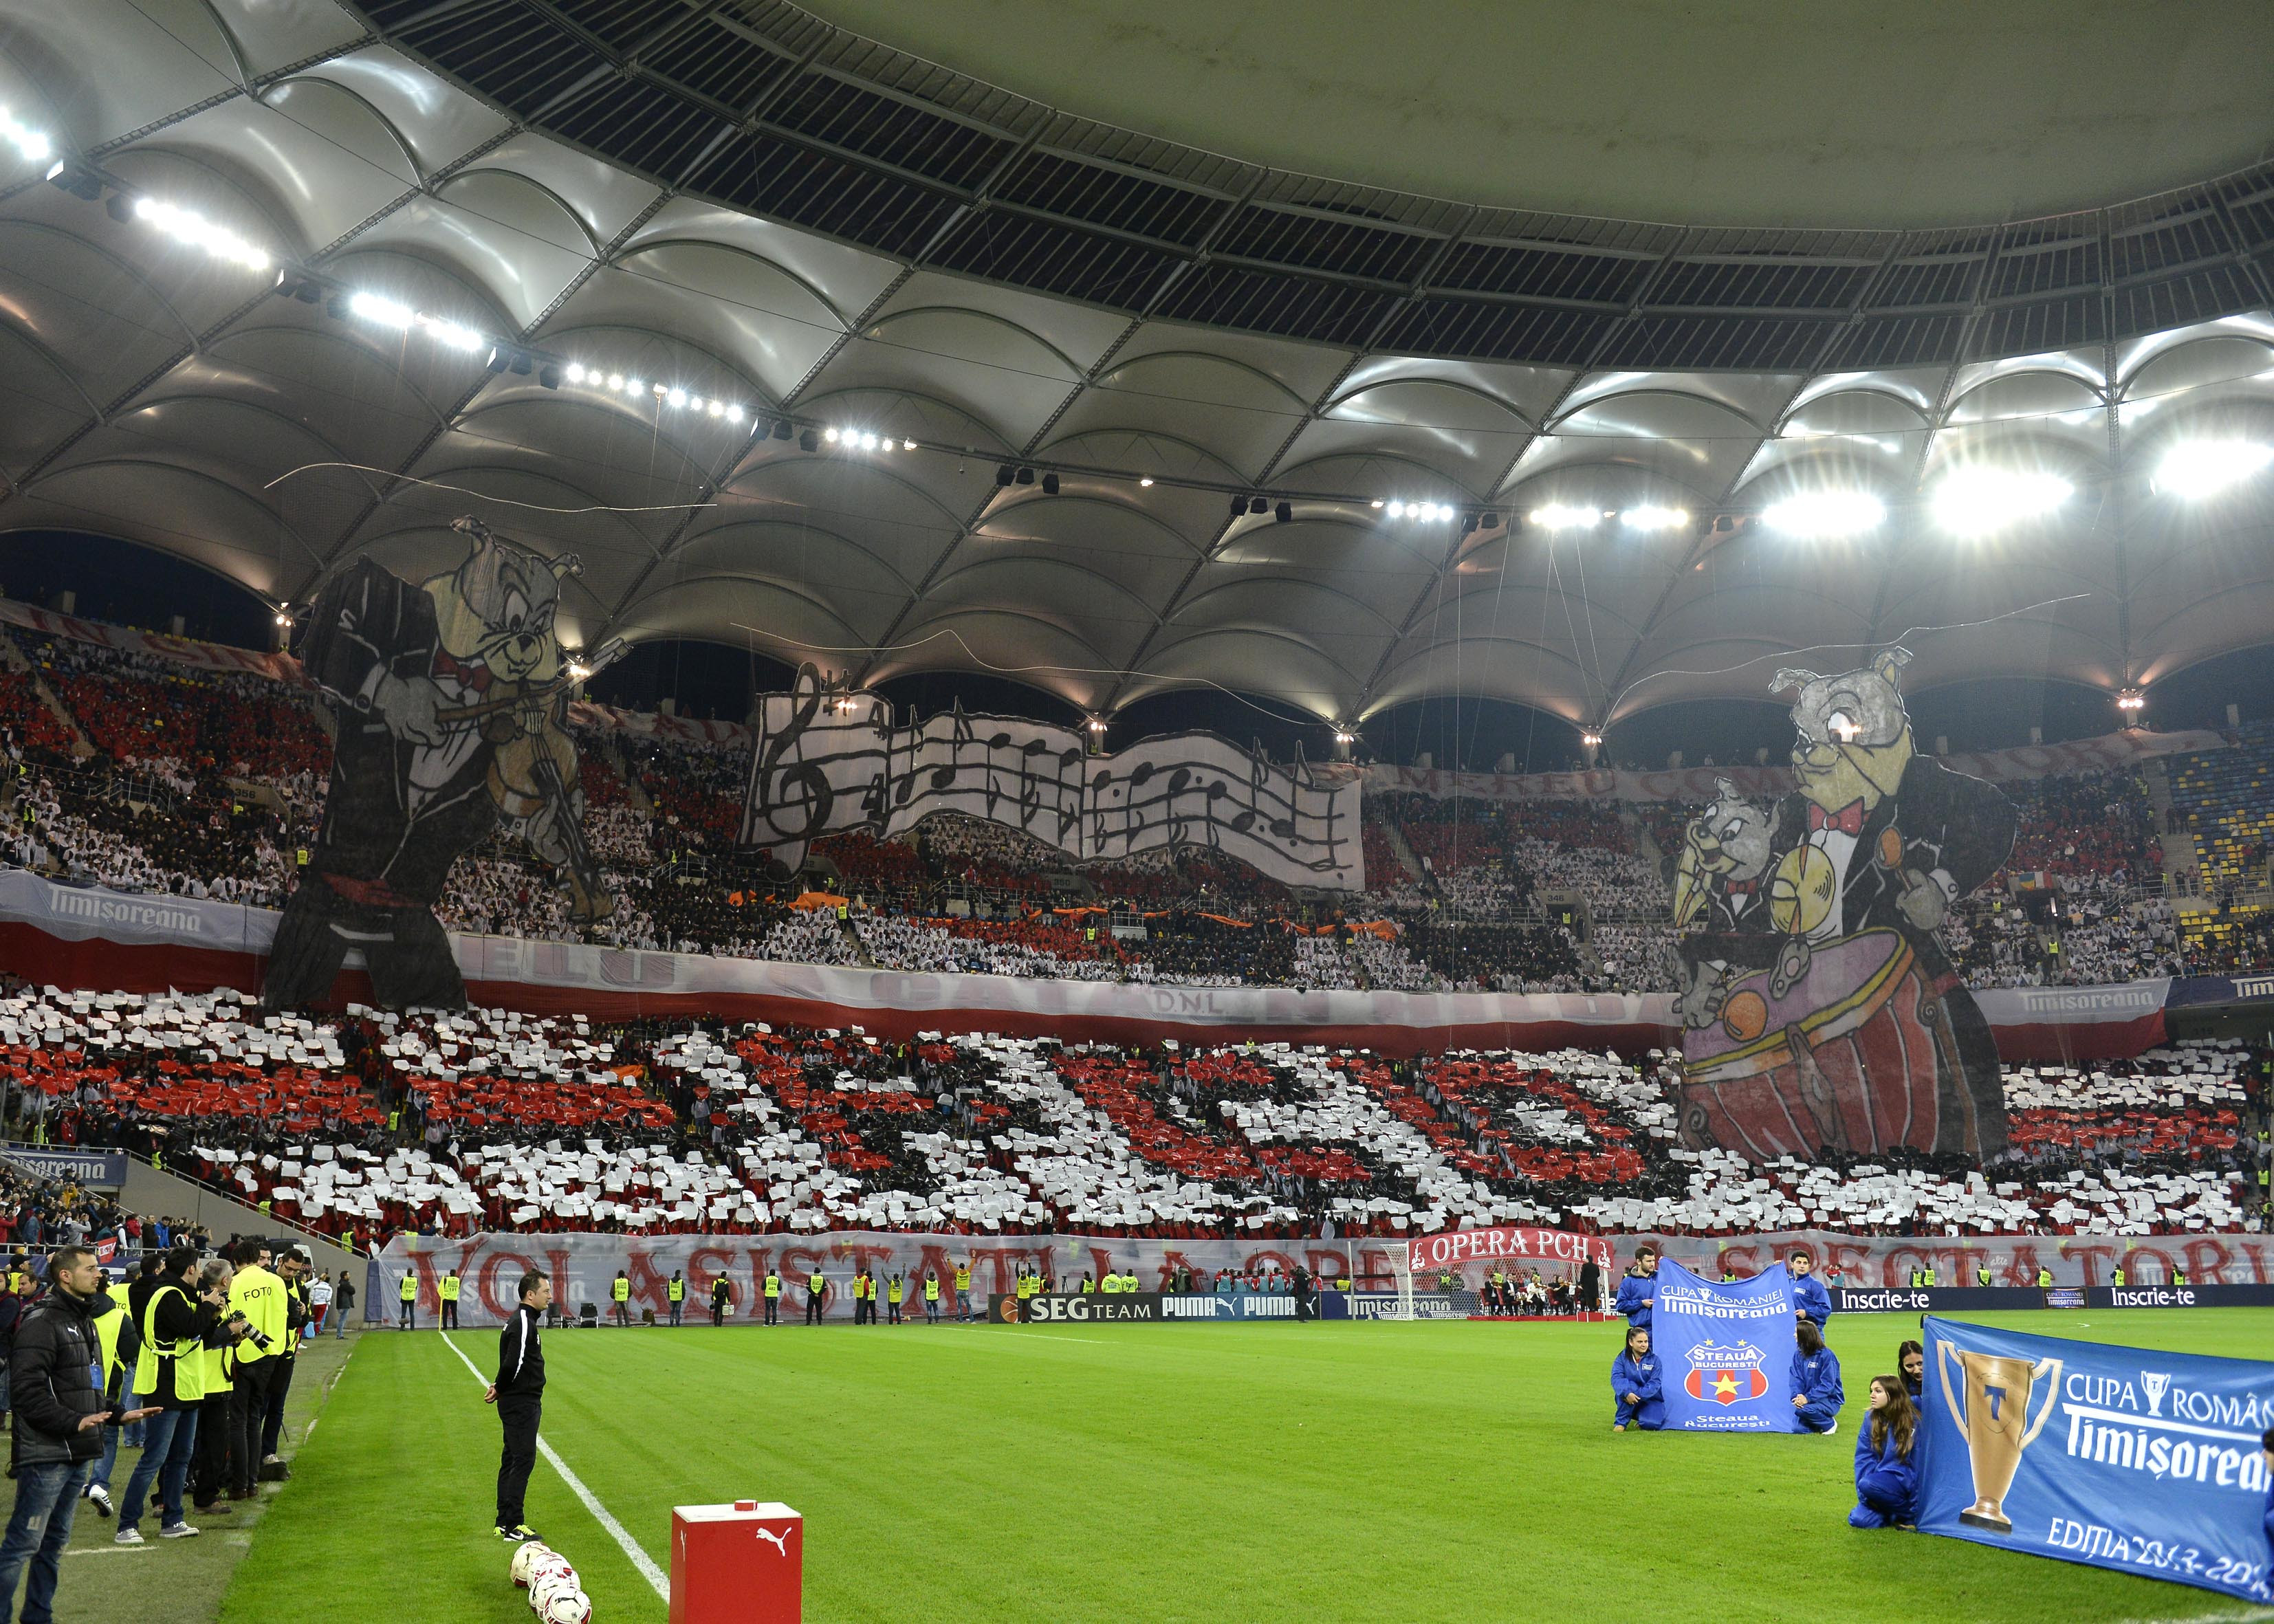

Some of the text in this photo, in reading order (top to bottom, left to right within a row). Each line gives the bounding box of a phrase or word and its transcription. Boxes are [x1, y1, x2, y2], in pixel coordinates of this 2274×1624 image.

[235, 789, 256, 799] 356
[1432, 1229, 1589, 1262] OPERA PCH
[407, 1238, 573, 1320] VOI
[243, 1286, 272, 1302] FOTO
[1661, 1285, 1698, 1299] CUPA
[1714, 1289, 1783, 1306] ROMÂNIEI
[1841, 1289, 1929, 1310] Inscrie-te
[2112, 1287, 2195, 1306] Inscrie-te
[1031, 1297, 1151, 1320] SEG TEAM
[1163, 1297, 1217, 1317] PUMA
[1244, 1297, 1295, 1316] PUMA
[1694, 1348, 1758, 1361] STEAUA
[2066, 1373, 2139, 1411] CUPA
